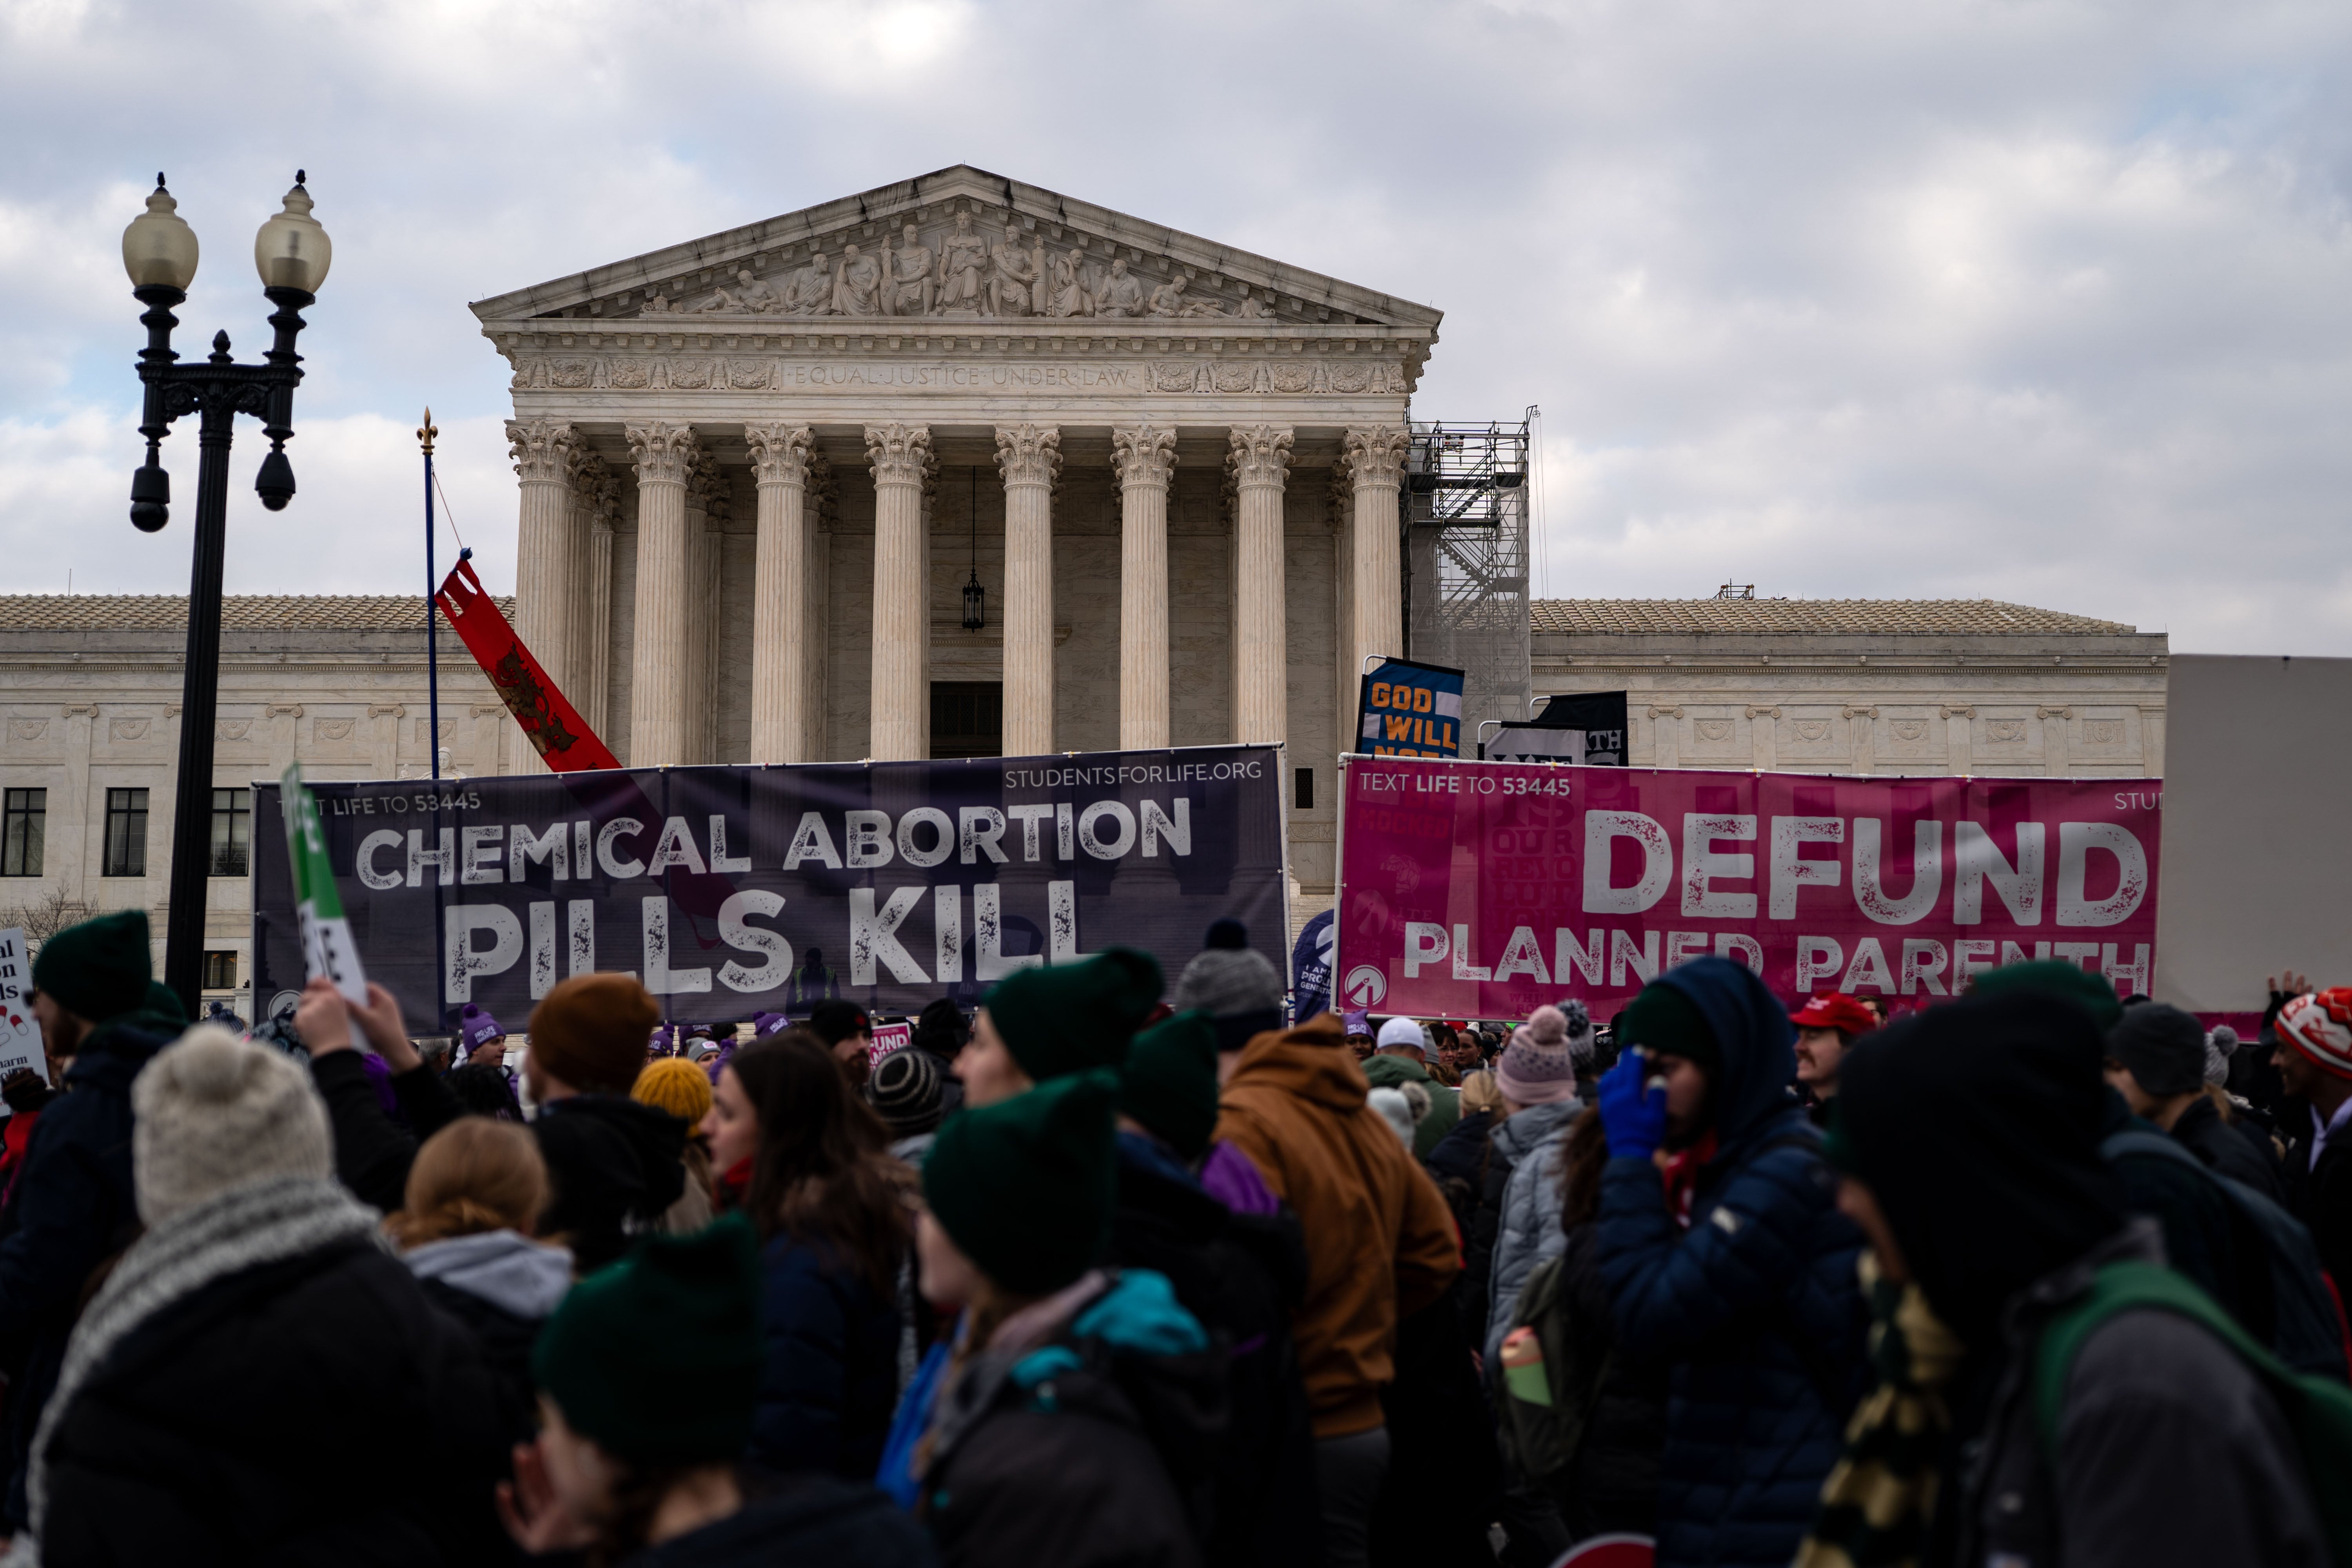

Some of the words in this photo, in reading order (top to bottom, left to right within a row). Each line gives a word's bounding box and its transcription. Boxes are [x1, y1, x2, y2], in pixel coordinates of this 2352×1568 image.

[795, 367, 878, 385] EQUAL
[884, 367, 979, 385] JUSTICE
[992, 368, 1077, 386] UNDER
[1082, 368, 1130, 386] LAW
[1371, 682, 1432, 713] GOD
[1385, 714, 1457, 750] WILL
[1005, 761, 1262, 788] STUDENTSFORLIFE.ORG
[1359, 773, 1410, 791] TEXT
[1416, 775, 1460, 793] LIFE
[1466, 776, 1495, 795] TO
[1503, 777, 1570, 796] 53445
[332, 797, 375, 815] LIFE
[379, 796, 408, 813] TO
[415, 792, 481, 813] 53445
[356, 814, 751, 890] CHEMICAL
[782, 797, 1191, 870] ABORTION
[1582, 809, 2148, 926] DEFUND
[445, 889, 794, 1004] PILLS
[849, 880, 1109, 986] KILL
